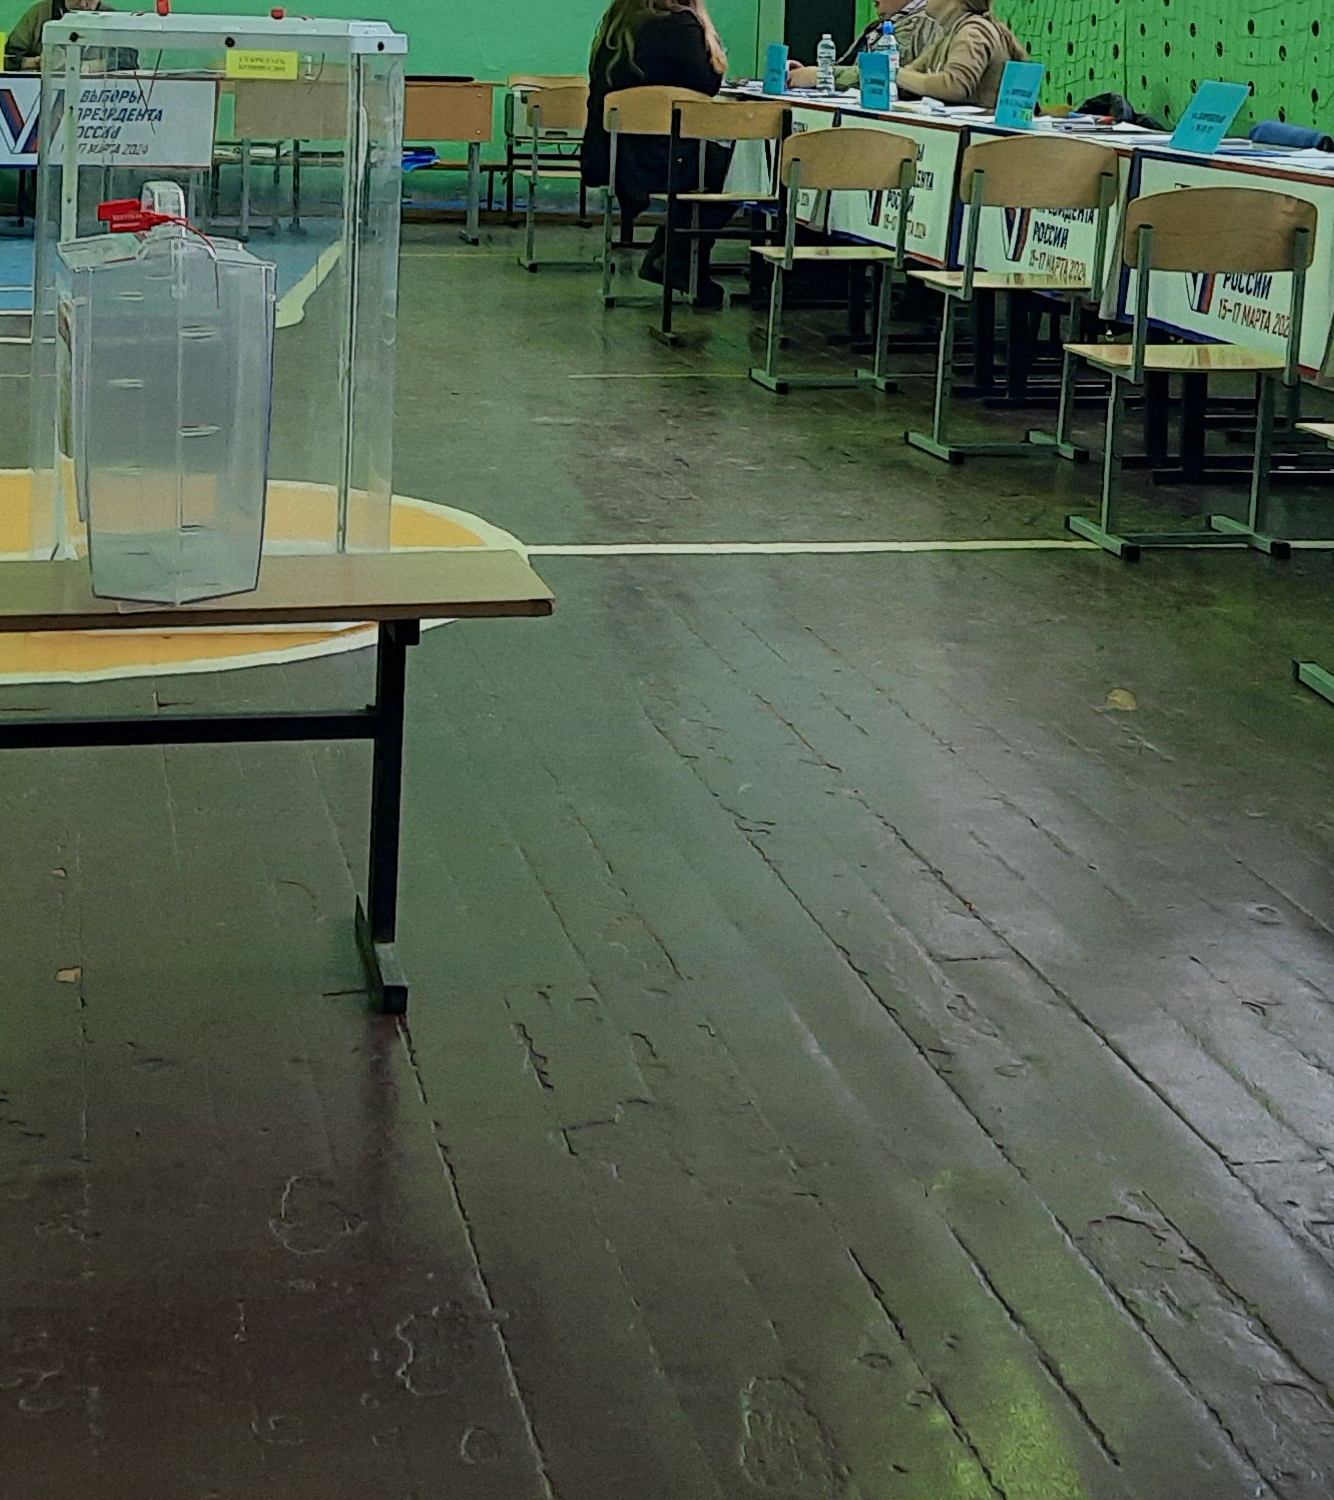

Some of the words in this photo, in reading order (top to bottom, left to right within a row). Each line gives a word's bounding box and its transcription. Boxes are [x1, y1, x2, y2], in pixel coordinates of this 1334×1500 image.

[80, 89, 142, 104] ВЫБОРЫ
[77, 125, 121, 139] ОССИИ
[1032, 221, 1069, 250] РОССИИ
[1223, 272, 1273, 300] РОССИИ
[1242, 304, 1272, 335] МАРТА
[1271, 313, 1291, 339] 202
